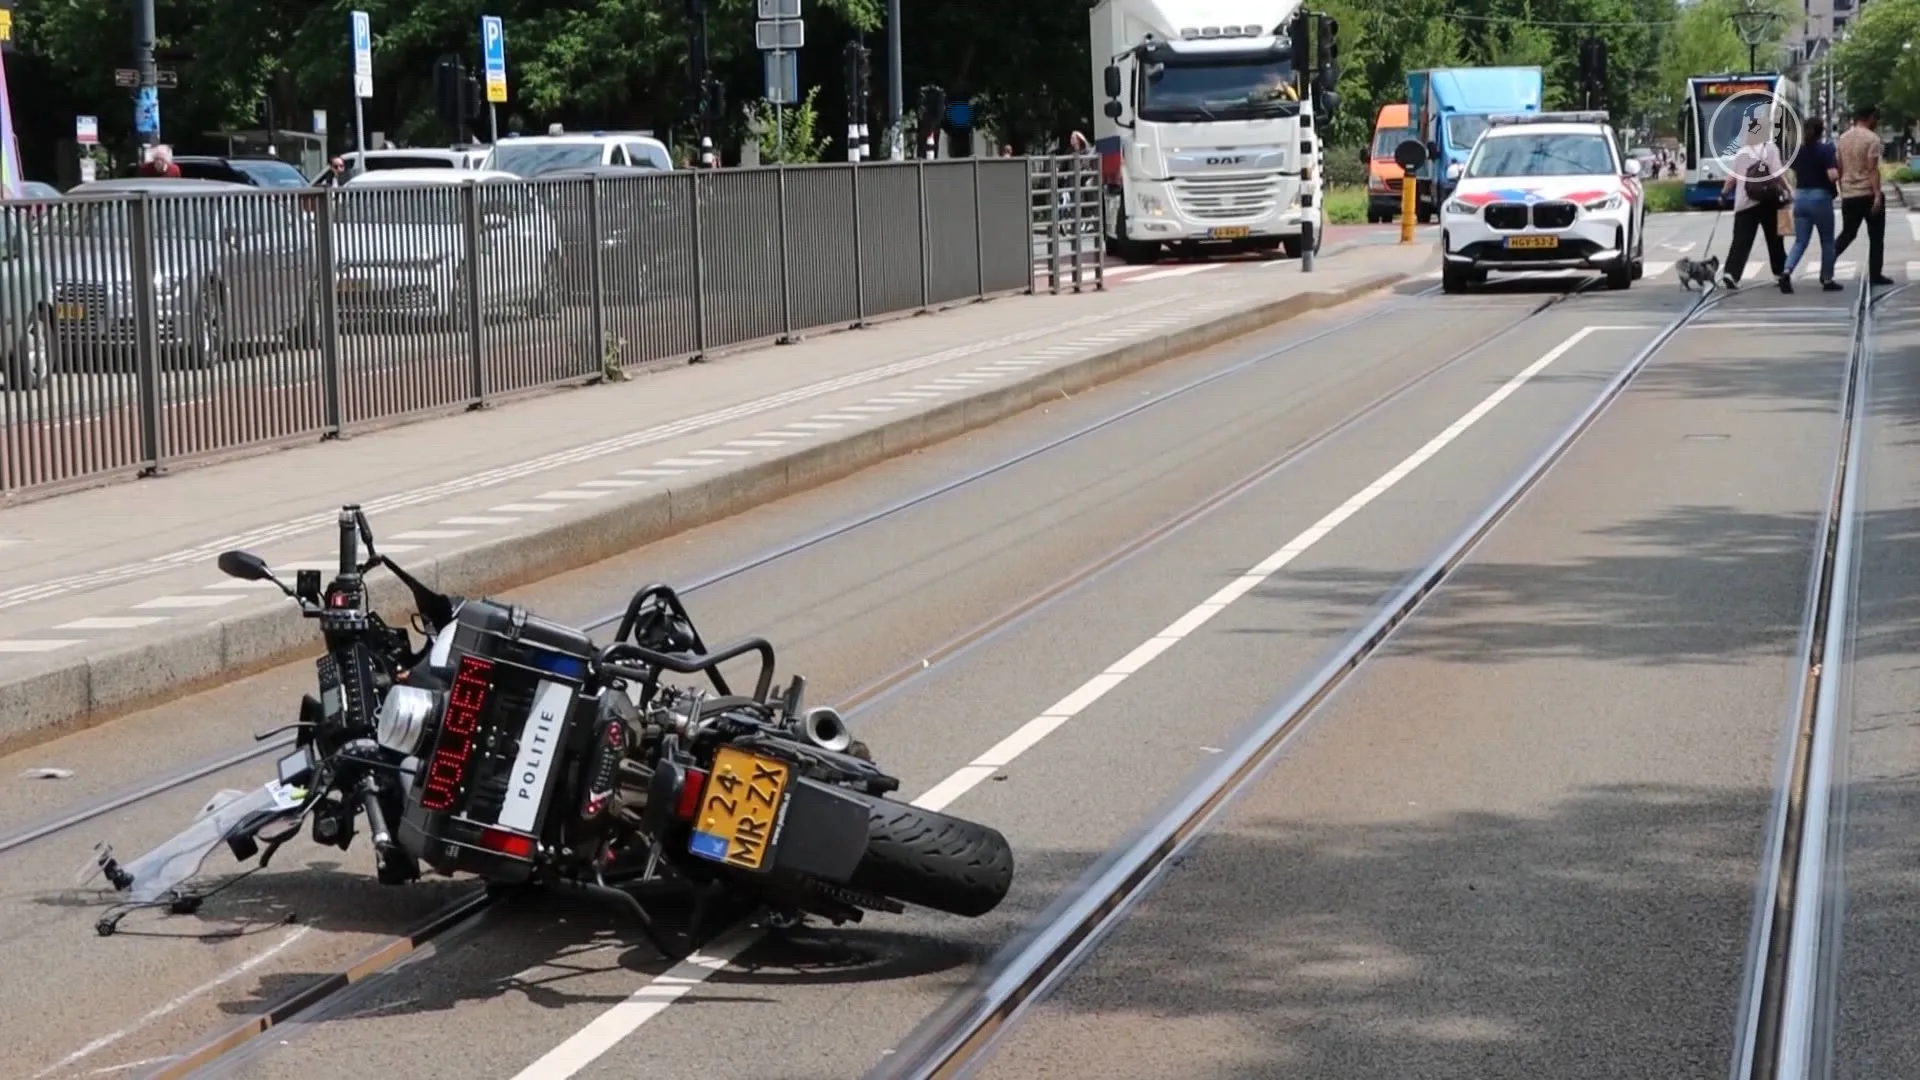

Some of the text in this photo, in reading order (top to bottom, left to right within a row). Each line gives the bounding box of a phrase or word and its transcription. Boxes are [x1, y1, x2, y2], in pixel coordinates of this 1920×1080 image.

[488, 22, 498, 49] P
[1206, 155, 1247, 165] DAF
[423, 658, 492, 809] VOLGEN
[518, 710, 554, 800] POLITIE
[708, 774, 743, 817] 24
[730, 761, 783, 864] MR-ZX
